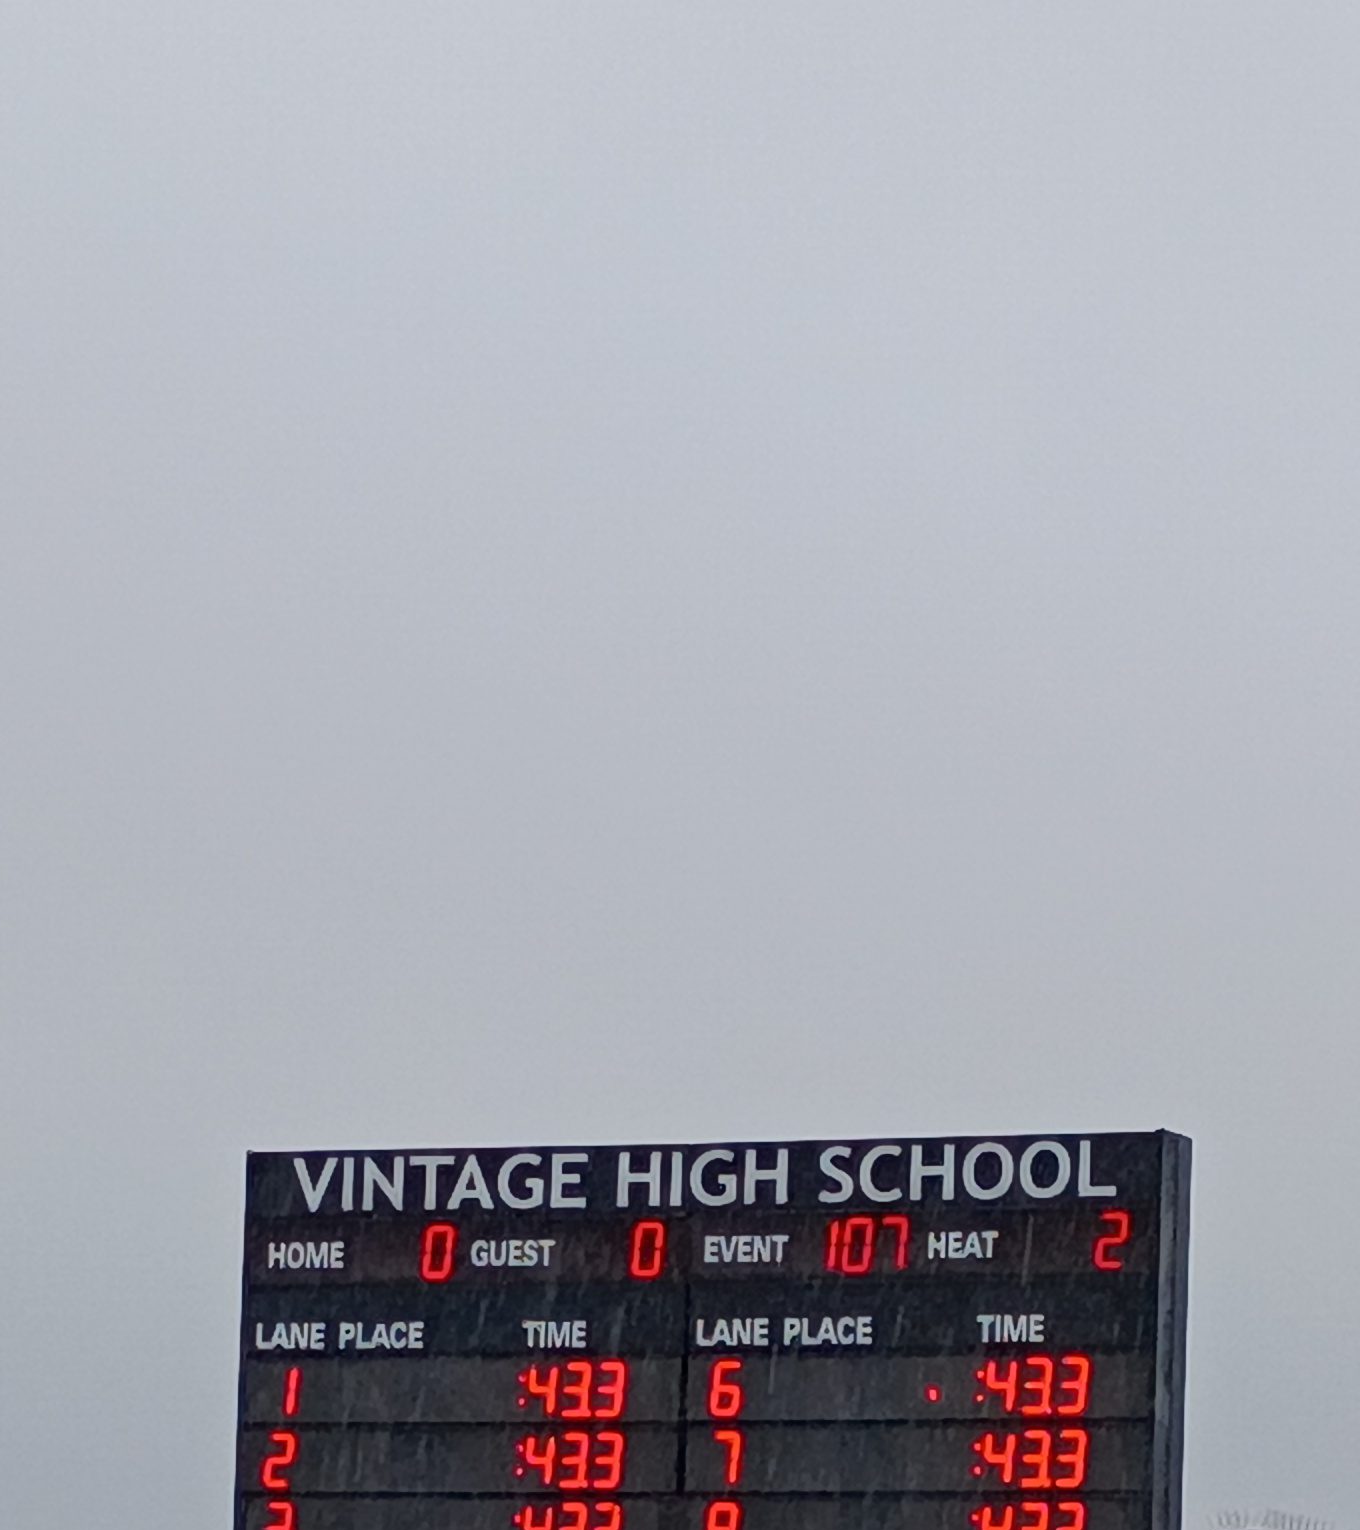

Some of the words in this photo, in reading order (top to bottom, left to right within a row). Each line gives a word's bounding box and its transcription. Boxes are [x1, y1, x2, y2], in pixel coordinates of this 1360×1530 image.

[294, 1153, 589, 1213] VINTAGE
[616, 1148, 789, 1207] HIGH
[818, 1140, 1117, 1203] SCHOOL
[268, 1241, 345, 1269] HOME
[420, 1222, 457, 1282] 0
[470, 1239, 556, 1267] GUEST
[629, 1220, 666, 1279] 0
[703, 1234, 789, 1263] EVENT
[826, 1215, 910, 1274] 107
[927, 1230, 999, 1260] HEAT
[1093, 1210, 1130, 1270] 2
[255, 1325, 326, 1351] LANE
[338, 1321, 424, 1350] PLACE
[522, 1320, 587, 1348] TIME
[696, 1319, 769, 1347] LANE
[783, 1315, 873, 1346] PLACE
[976, 1314, 1045, 1343] TIME
[284, 1366, 301, 1416] 1
[708, 1358, 743, 1419] 6
[261, 1432, 297, 1490] 2
[713, 1429, 743, 1485] 7
